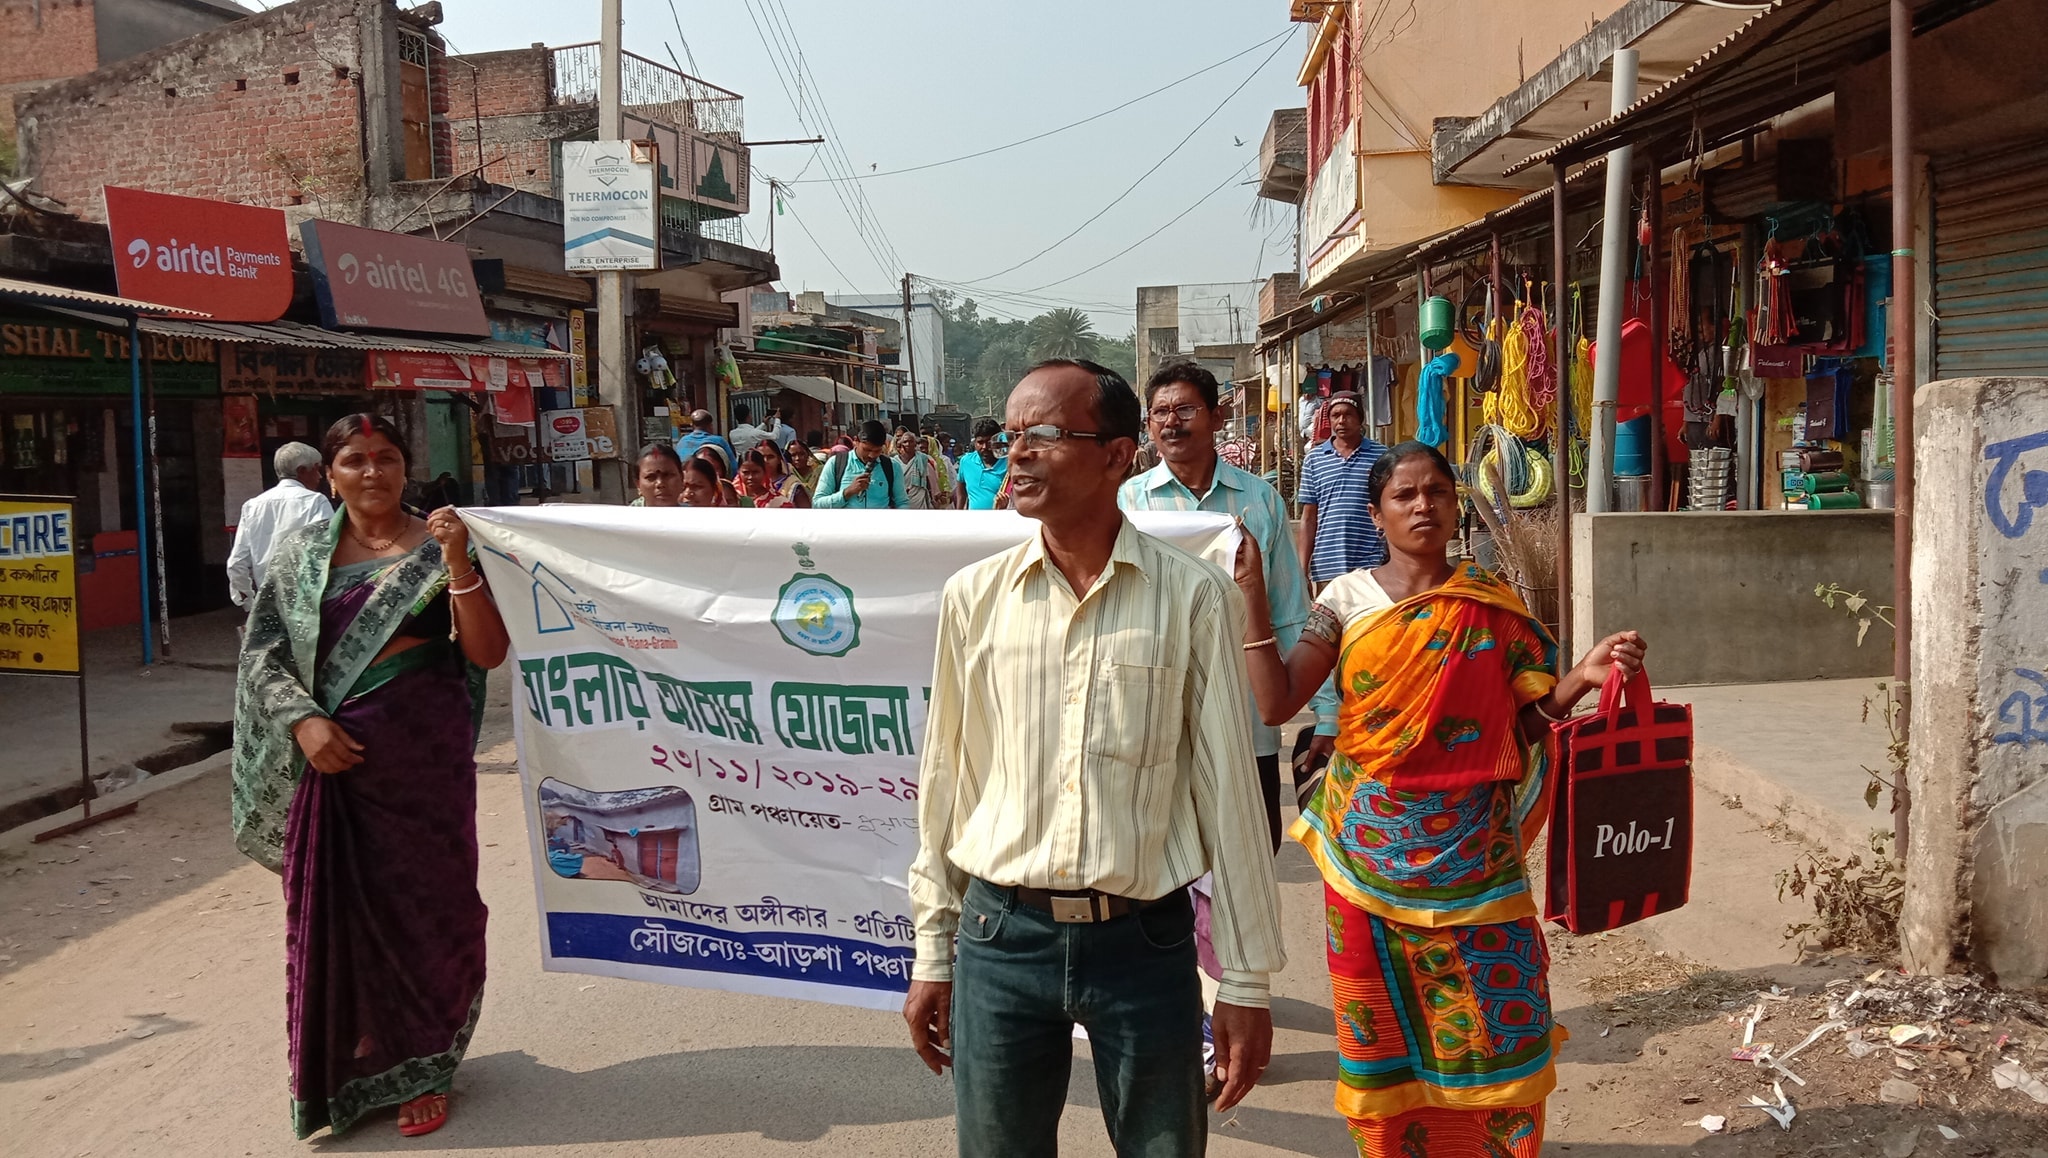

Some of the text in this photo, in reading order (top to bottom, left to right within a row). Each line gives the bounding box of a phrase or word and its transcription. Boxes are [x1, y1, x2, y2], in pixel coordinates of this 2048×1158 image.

[588, 167, 630, 175] THERMOCON
[568, 190, 649, 202] THERMOCON
[156, 238, 281, 276] airtel Payments
[228, 265, 259, 280] Bank
[595, 257, 640, 265] ENTERPRISE
[365, 253, 469, 299] airtel 4G
[96, 331, 216, 363] TEECOM
[641, 670, 765, 746] আবাস
[770, 681, 915, 756] যোজনা
[708, 794, 747, 817] গ্রাম
[1593, 817, 1675, 858] Polo-1
[639, 891, 728, 925] আমাদের
[734, 896, 828, 930] অঙ্গীকার
